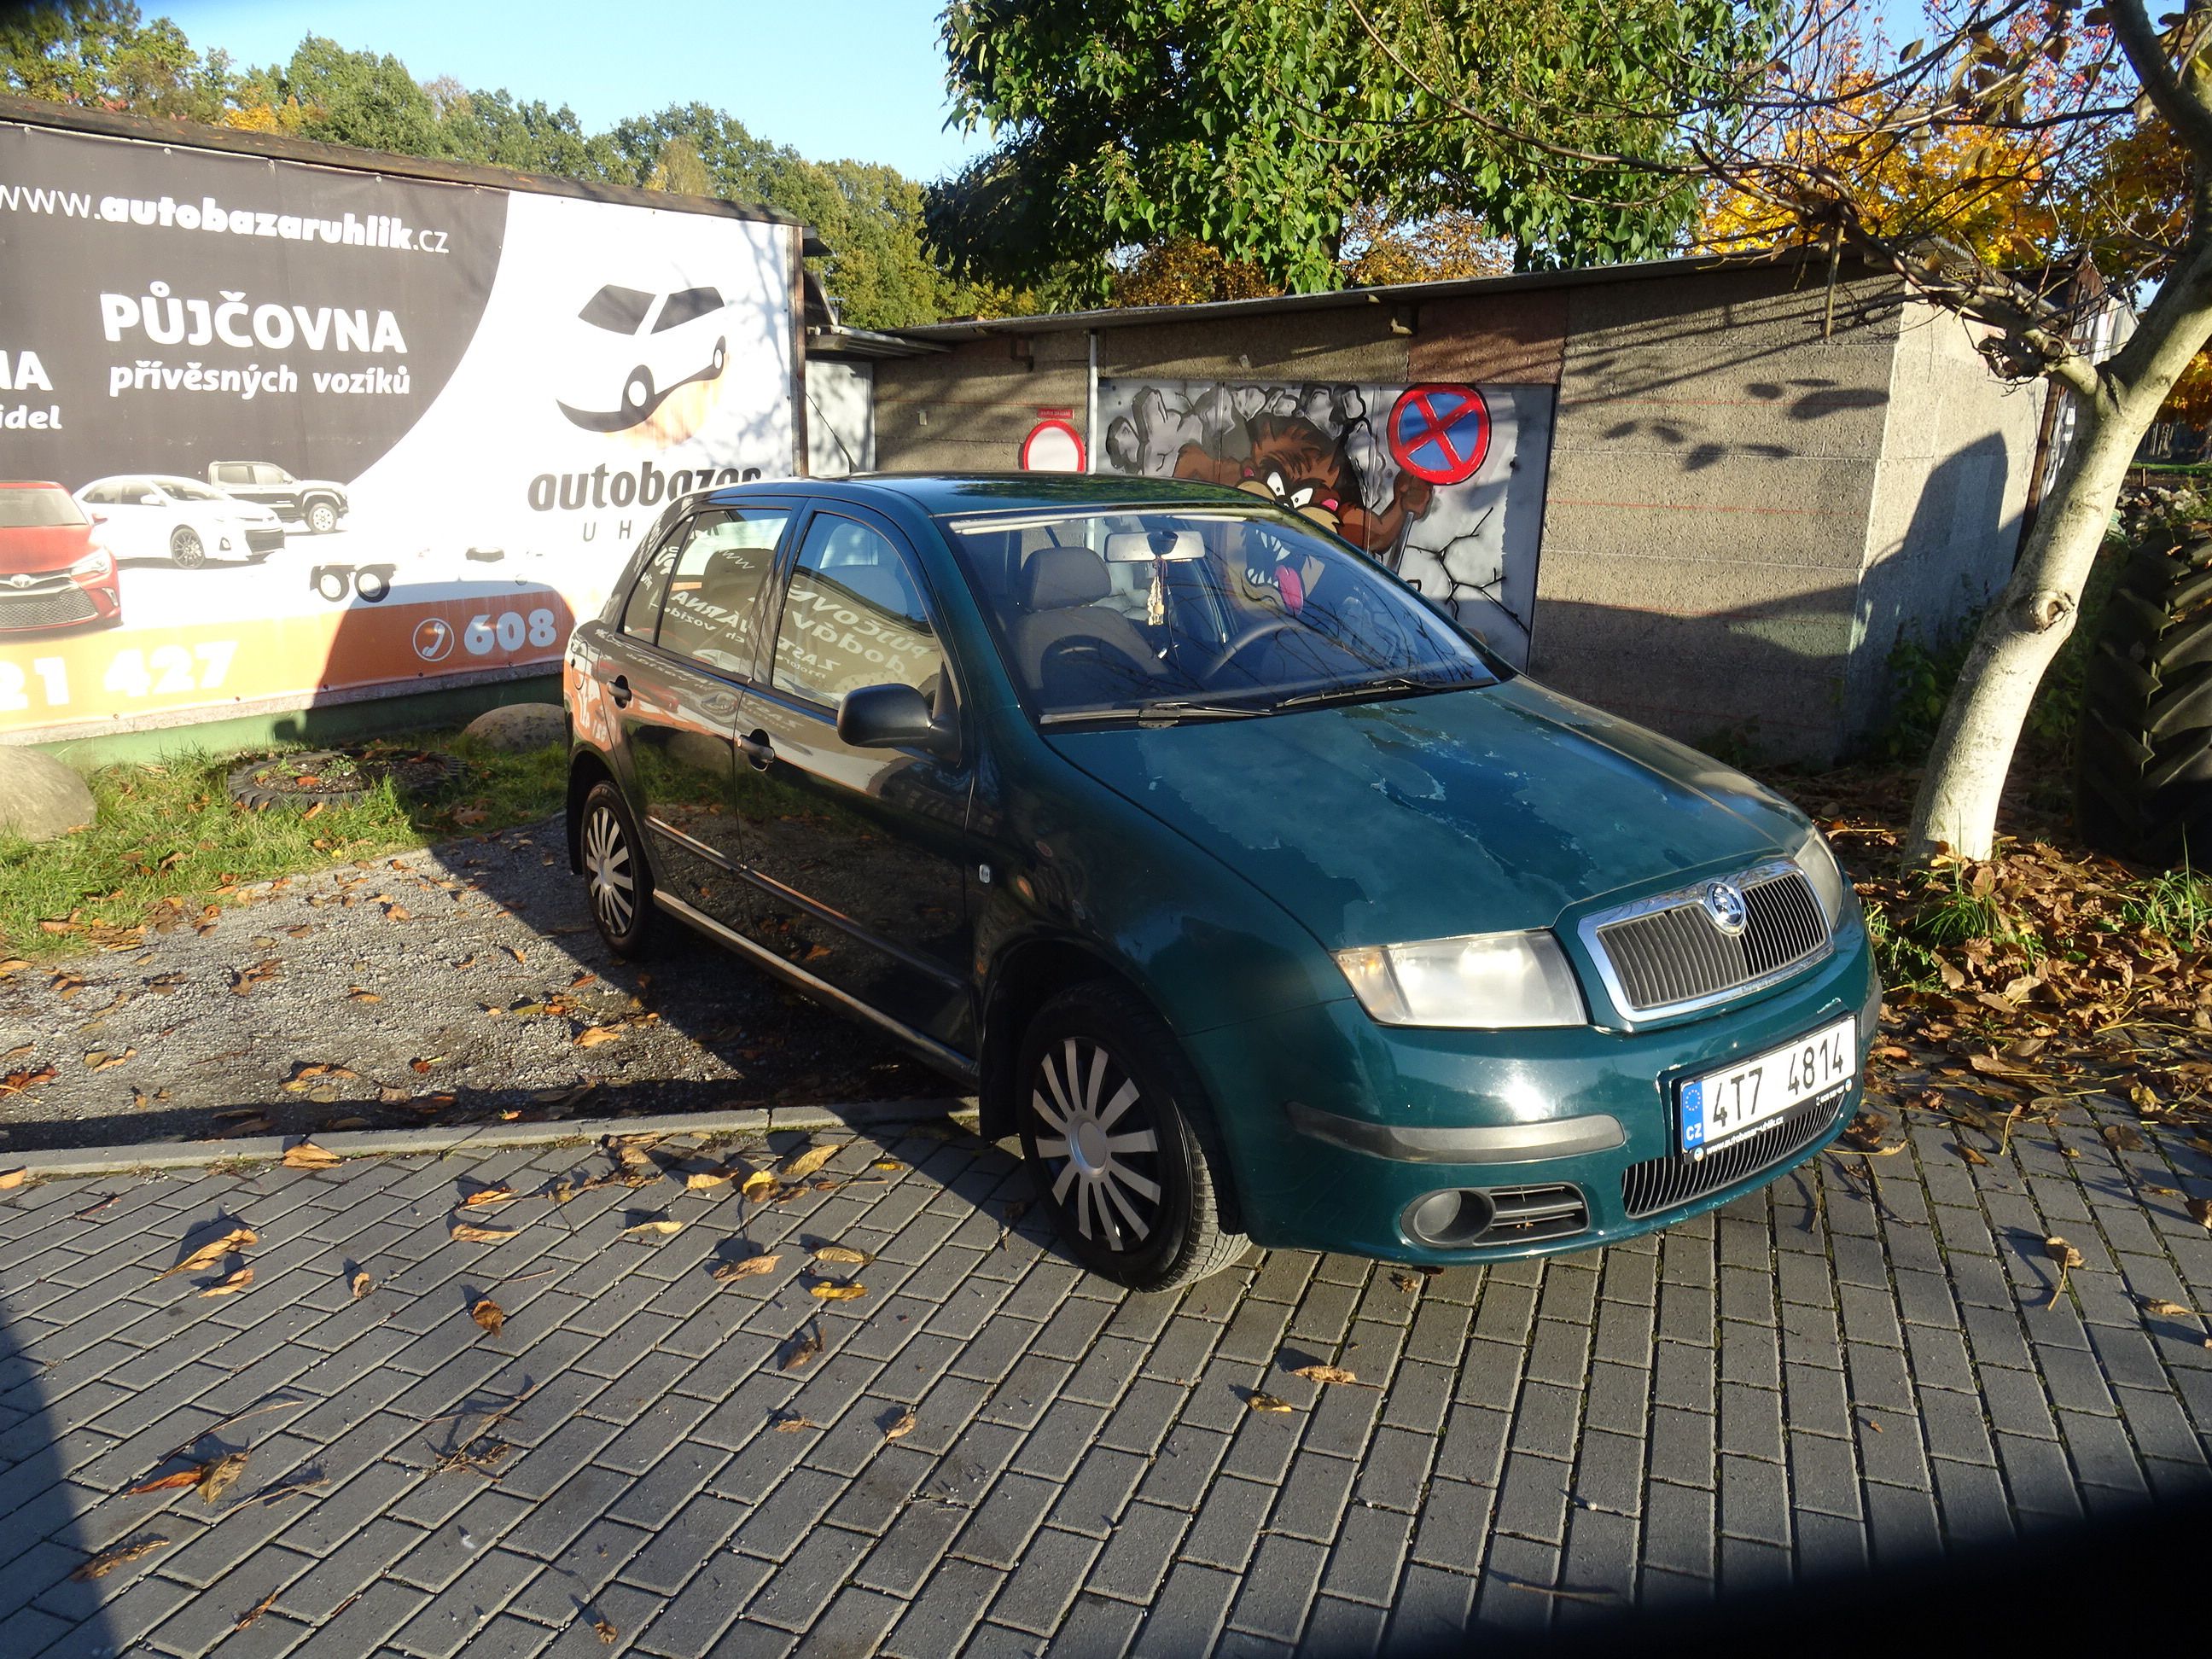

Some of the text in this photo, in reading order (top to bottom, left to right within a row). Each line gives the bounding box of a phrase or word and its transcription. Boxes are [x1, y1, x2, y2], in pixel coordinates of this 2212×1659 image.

[0, 184, 450, 254] www.autobazaruhlik.cz
[99, 280, 408, 354] PŮJČOVNA
[109, 359, 411, 400] přívěsných vozíků
[463, 608, 556, 656] 608
[102, 641, 239, 698] 427
[1713, 1033, 1843, 1127] 4T7 4814
[1685, 1122, 1703, 1142] CZ
